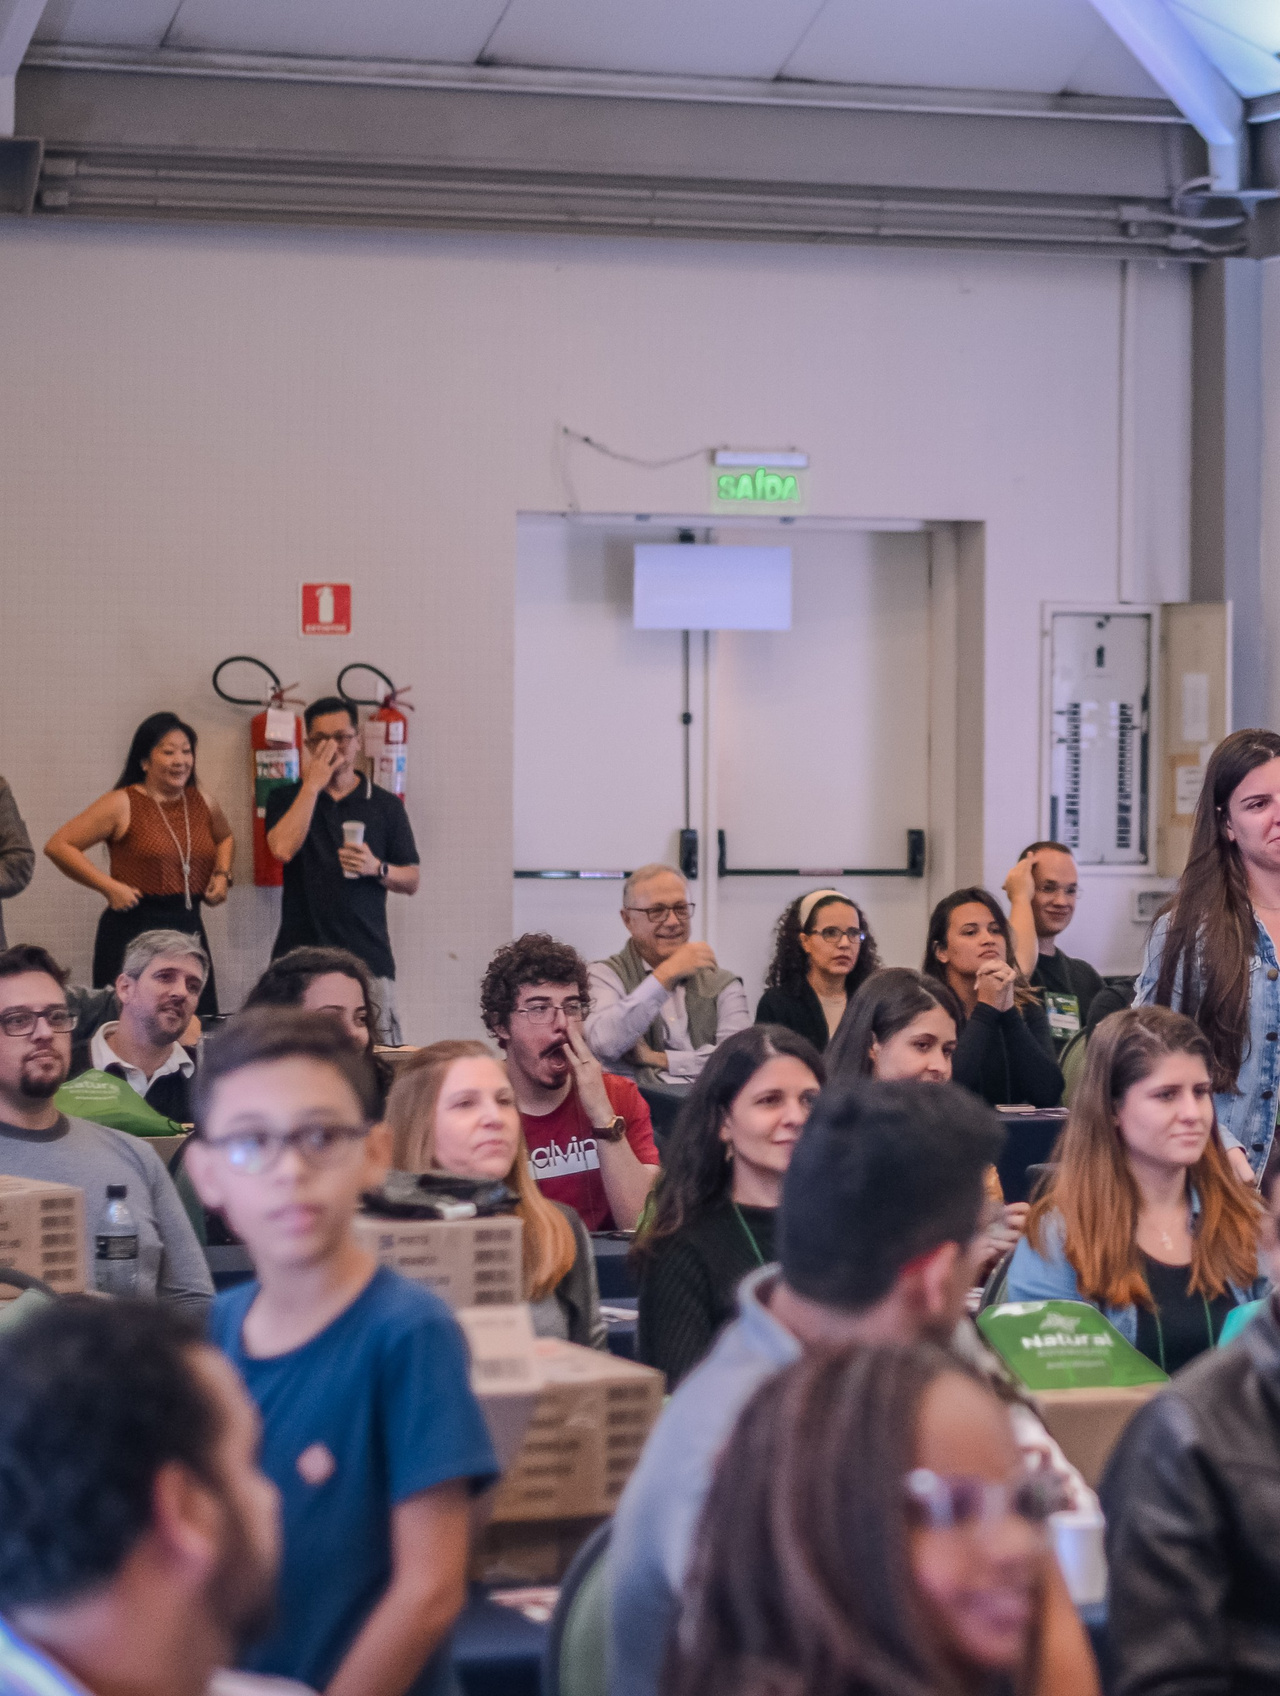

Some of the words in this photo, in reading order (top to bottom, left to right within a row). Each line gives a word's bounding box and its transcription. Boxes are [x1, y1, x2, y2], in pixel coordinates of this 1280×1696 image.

[718, 468, 798, 500] SAÍDA
[530, 1136, 598, 1168] alvin
[1021, 1331, 1114, 1349] Natural
